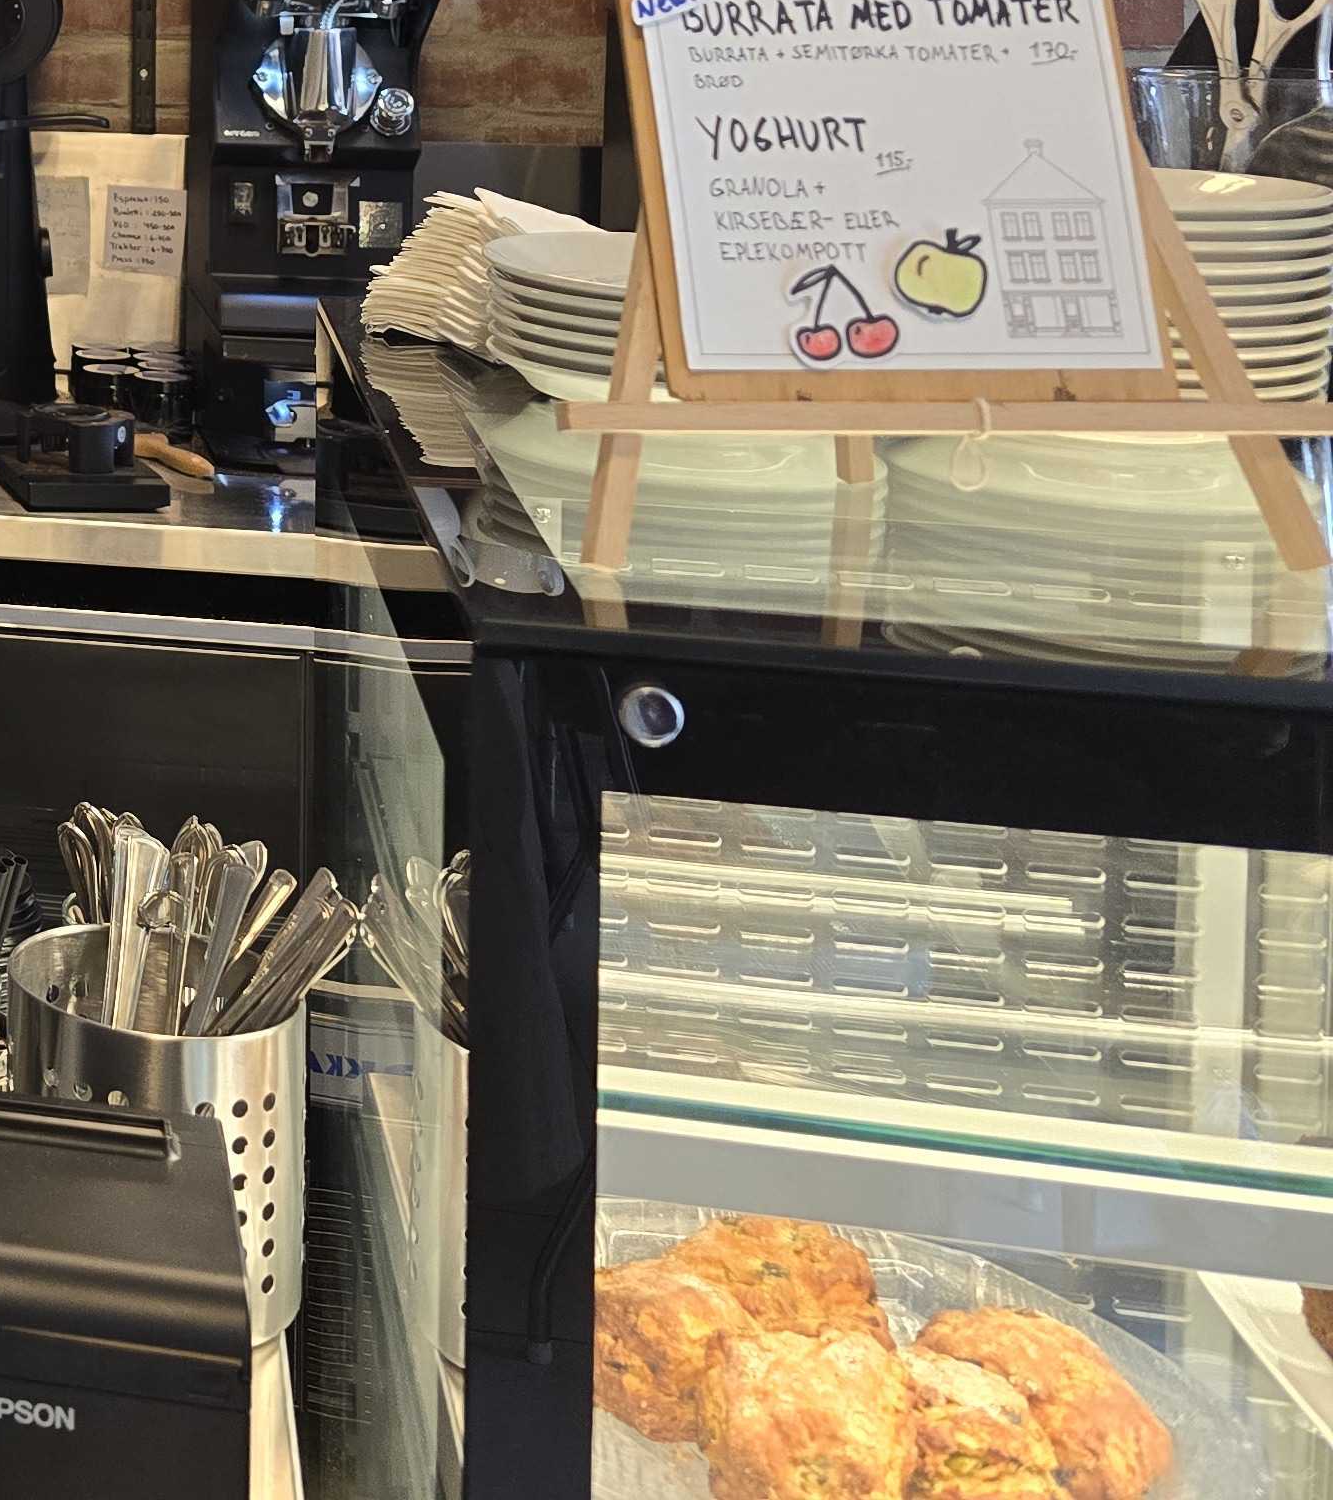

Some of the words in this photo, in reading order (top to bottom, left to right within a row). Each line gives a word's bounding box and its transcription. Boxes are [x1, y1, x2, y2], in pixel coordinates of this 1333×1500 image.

[688, 46, 769, 63] BURRATA
[791, 44, 899, 63] SEMITØRKA
[904, 44, 997, 63] TOMATER
[694, 75, 744, 90] BRØD
[695, 115, 866, 161] YOGHURT
[709, 177, 809, 198] GRANOLA
[845, 210, 900, 231] ELLER
[721, 241, 868, 262] EPLEKOMPOTT
